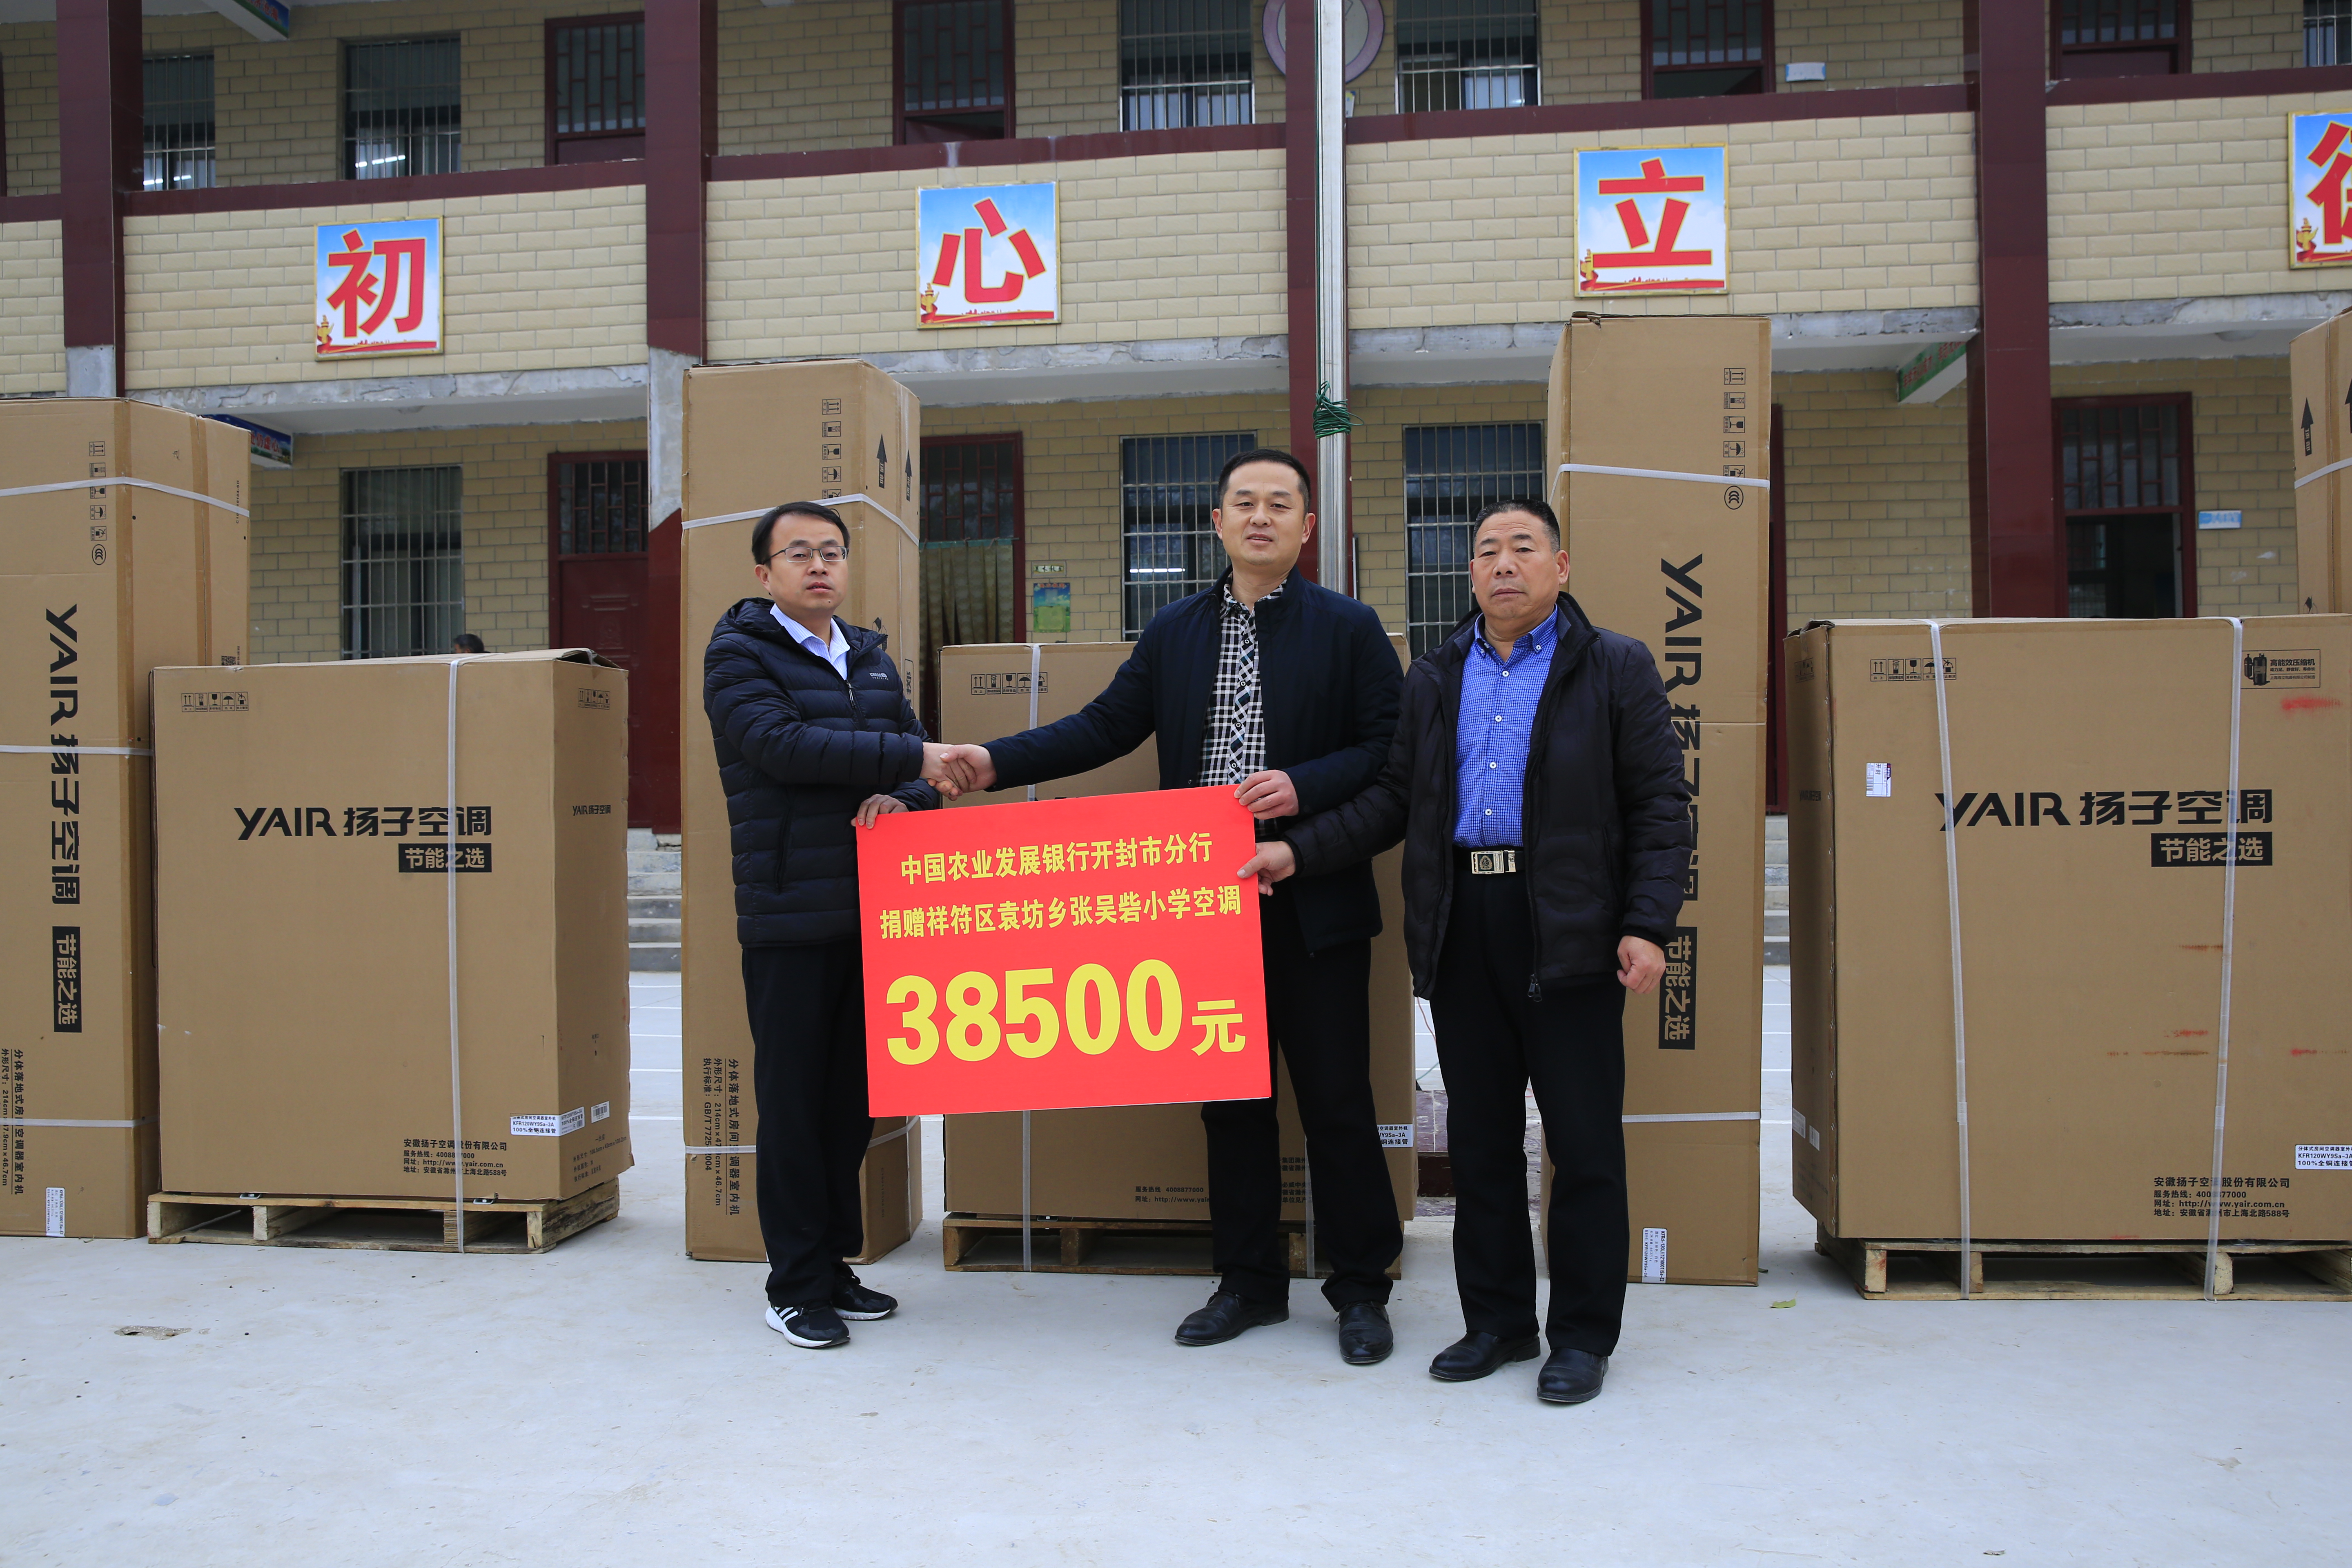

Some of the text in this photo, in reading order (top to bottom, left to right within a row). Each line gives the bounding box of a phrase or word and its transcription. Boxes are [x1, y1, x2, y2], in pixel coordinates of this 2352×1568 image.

[1592, 157, 1713, 269] 立
[931, 197, 1047, 304] 心
[327, 229, 425, 338] 初
[1661, 553, 1702, 693] YAIR
[46, 604, 80, 904] YAIR 扬子空调
[234, 806, 492, 840] YAIR 扬子空调
[572, 805, 611, 816] YAIR 扬子空调
[1934, 789, 2272, 831] YAIR 扬子空调
[405, 847, 485, 869] 节能之选
[900, 832, 1213, 885] 中国农业发展银行开封市分行
[2160, 838, 2263, 862] 节能之选
[880, 884, 1242, 940] 捐赠祥符区袁坊乡张吴砦小学空调
[56, 935, 78, 1025] 节能之选
[1664, 935, 1692, 1040] 节能之选
[886, 959, 1246, 1066] 38500元
[403, 1166, 507, 1176] 地址：安徽省滁州上海北路588号
[2154, 1208, 2290, 1218] 地址：安徽省滁市上海北路588号
